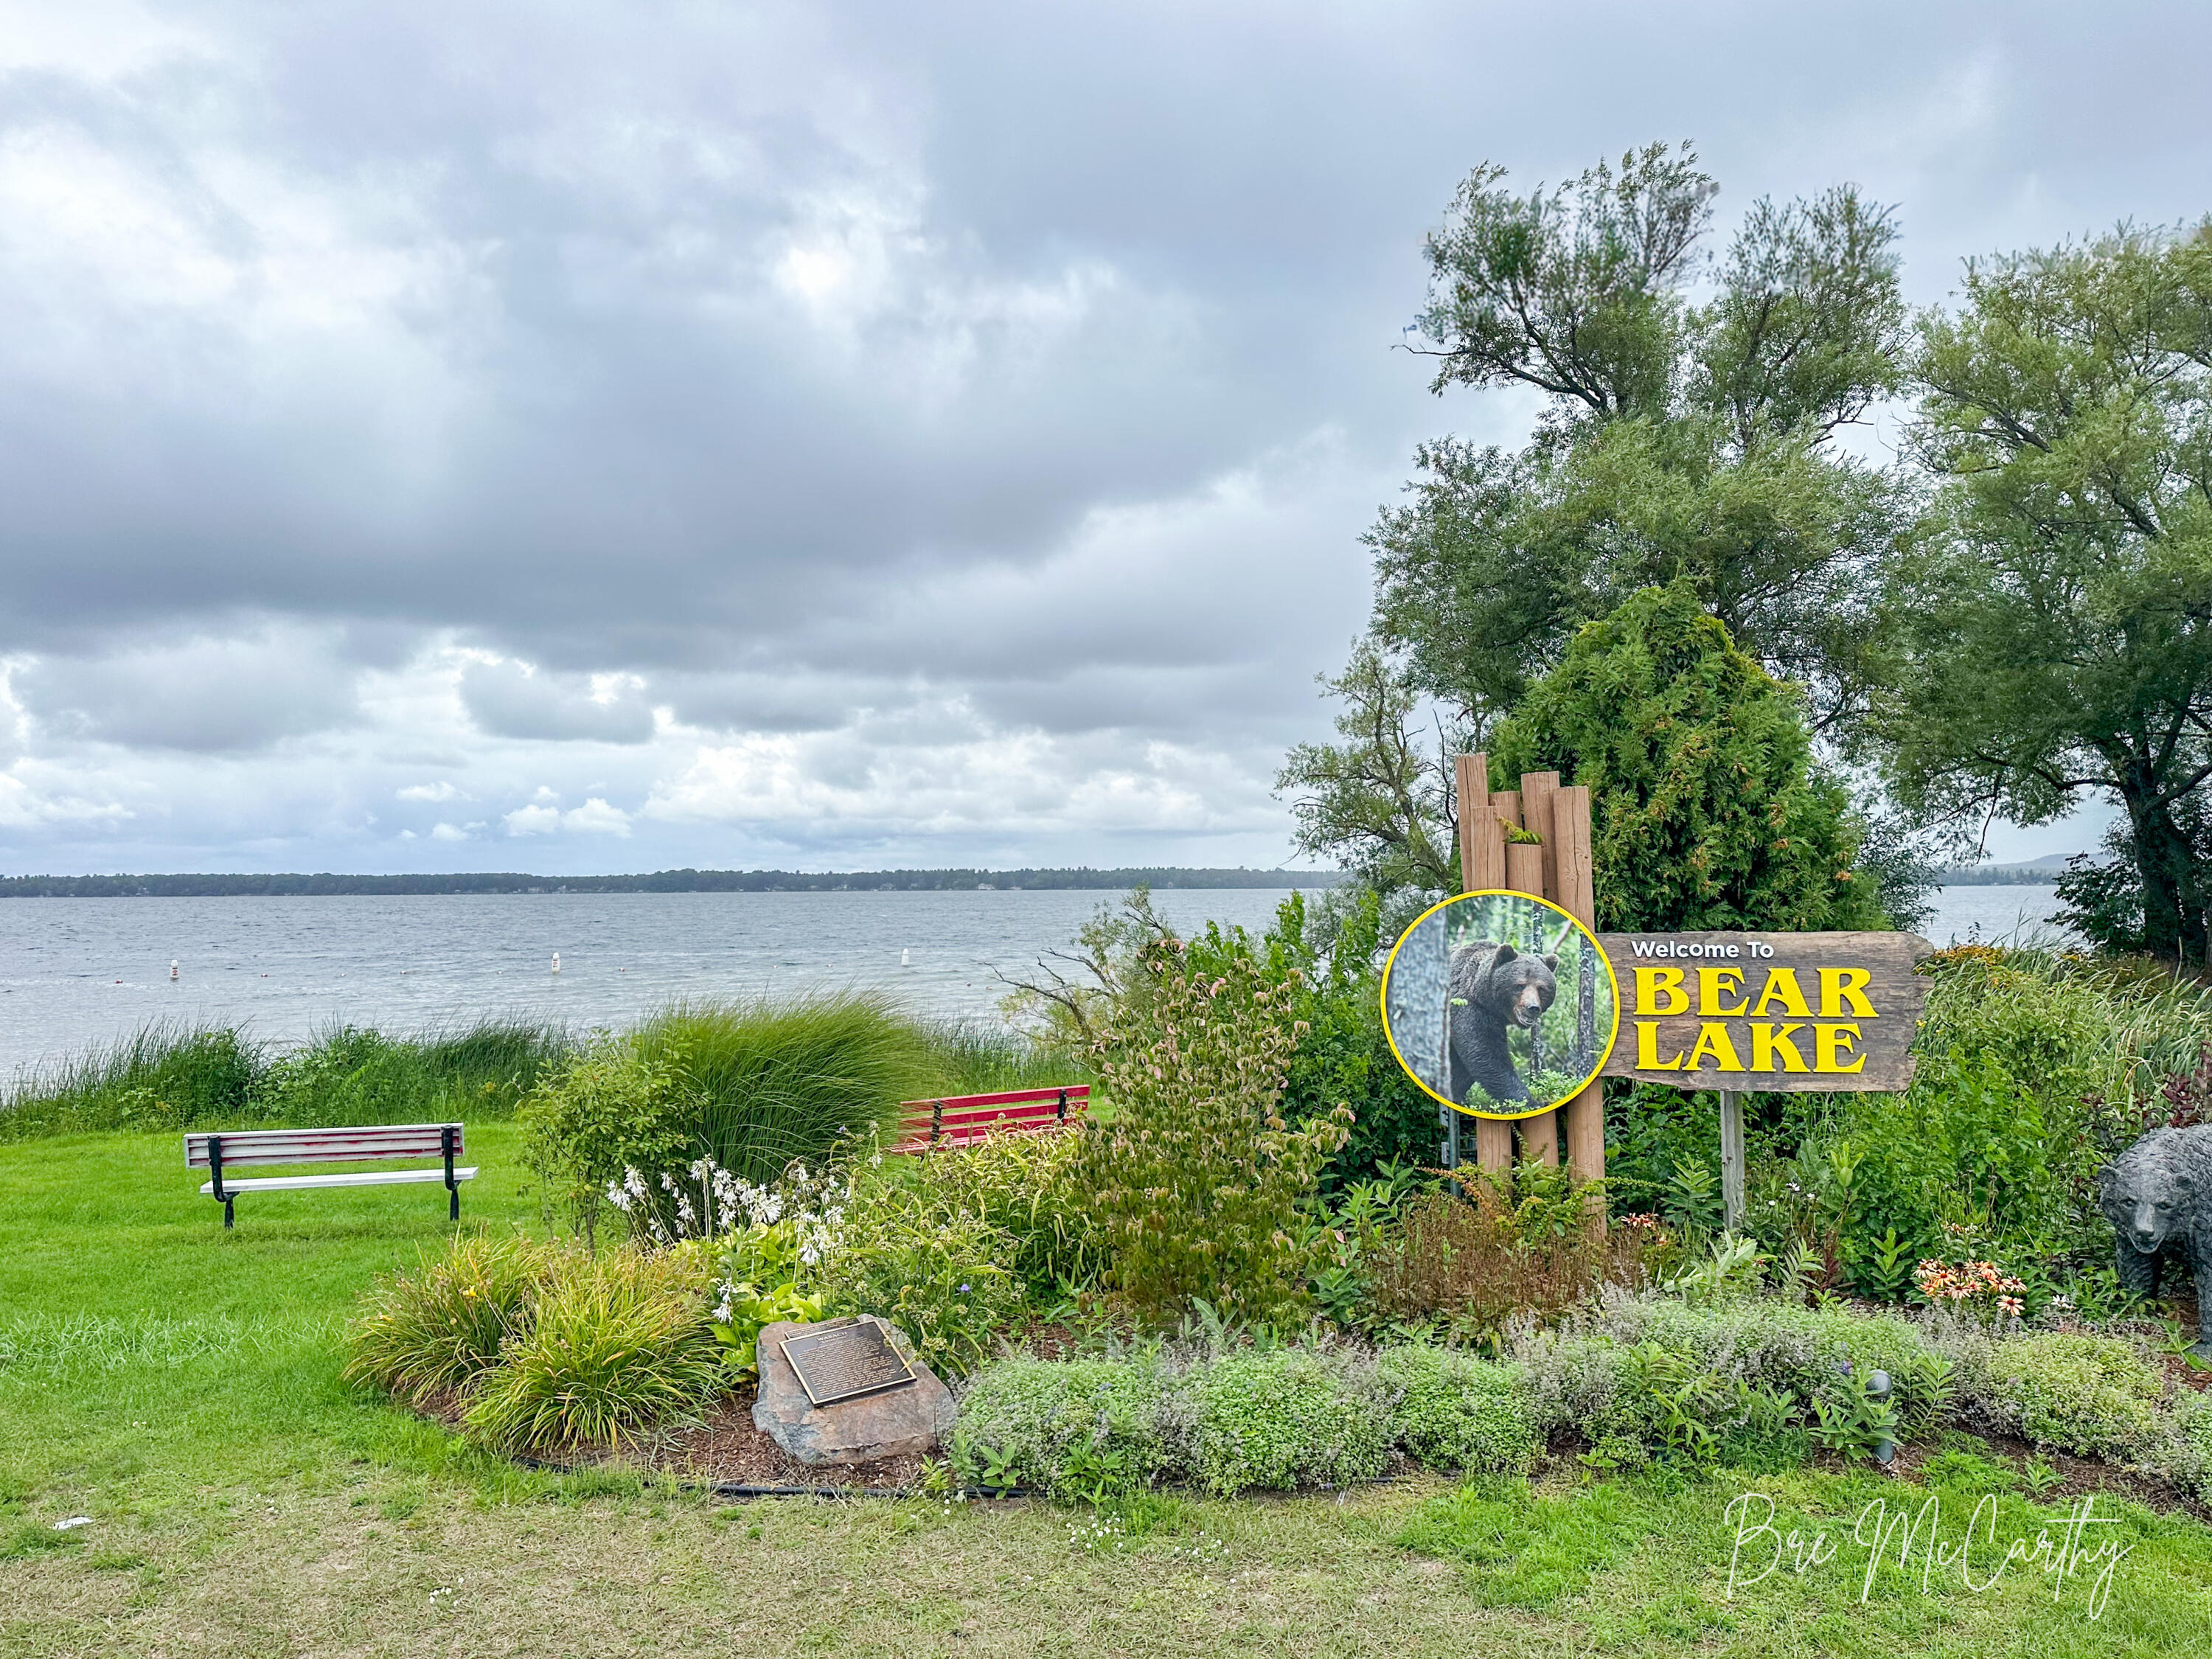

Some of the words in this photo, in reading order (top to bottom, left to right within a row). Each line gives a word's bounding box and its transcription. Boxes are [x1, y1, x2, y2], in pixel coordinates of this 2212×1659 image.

[1631, 940, 1739, 958] Welcome
[1746, 941, 1775, 958] To
[1632, 967, 1879, 1018] BEAR
[1634, 1021, 1867, 1074] LAKE
